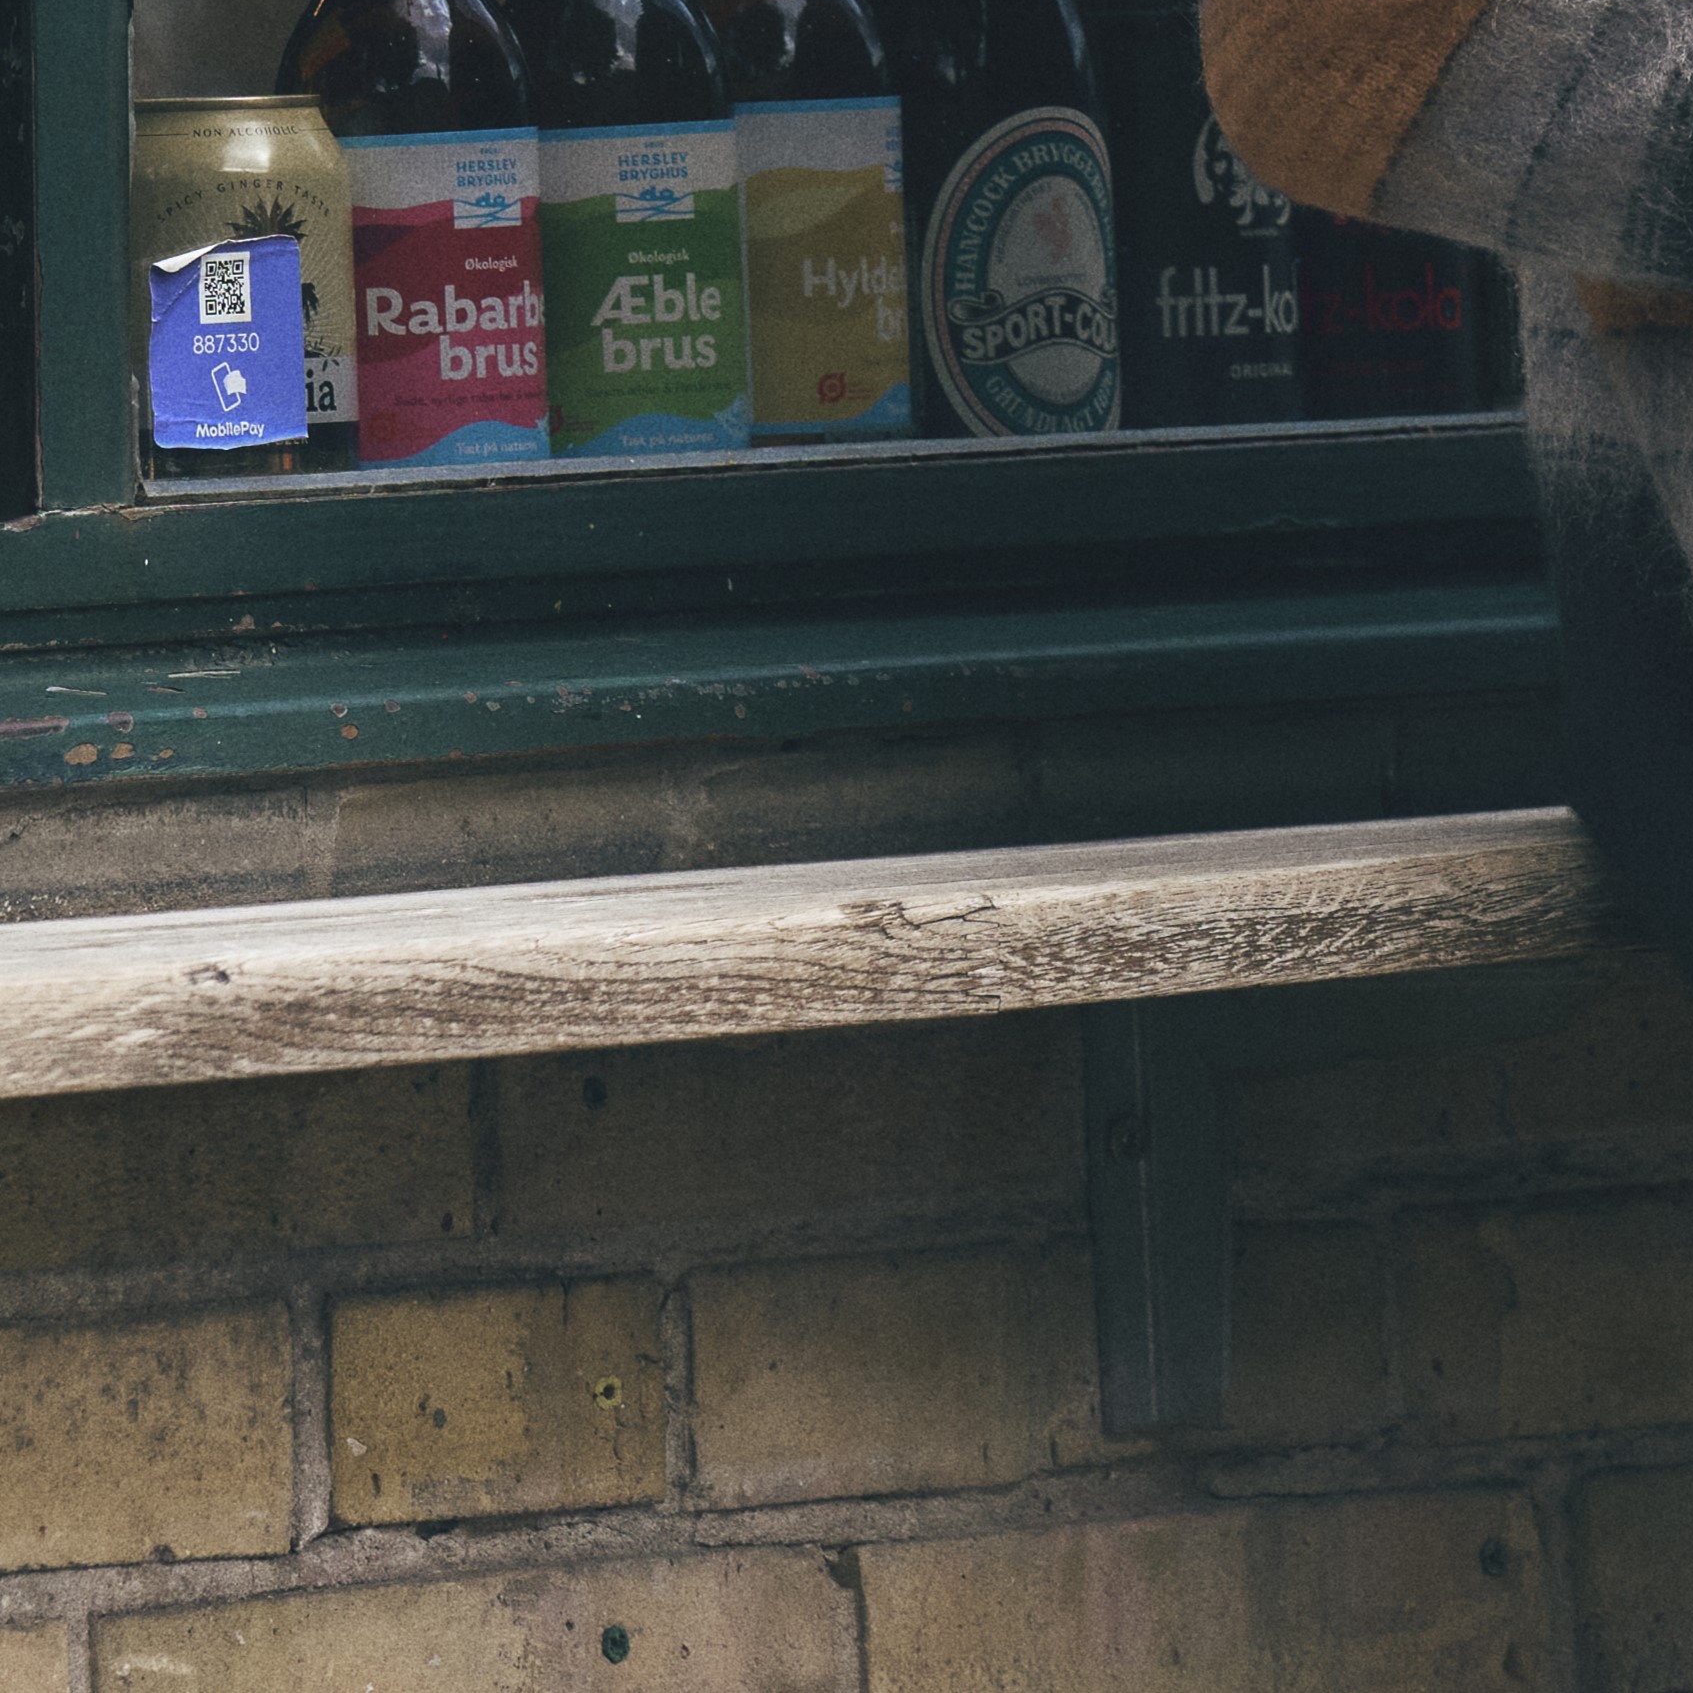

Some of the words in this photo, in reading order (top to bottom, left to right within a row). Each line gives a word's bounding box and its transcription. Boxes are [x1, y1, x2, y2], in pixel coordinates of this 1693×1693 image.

[192, 127, 222, 139] NON
[228, 125, 299, 138] ALCOHOLIC
[455, 158, 518, 174] HERSLEV
[618, 152, 689, 168] HERSLEV
[456, 172, 518, 188] BRYGHUS
[618, 166, 689, 182] BRYGHUS
[216, 178, 285, 195] GINGER
[954, 166, 1015, 291] HANCOCK
[464, 254, 518, 272] Økologisk
[627, 248, 691, 265] Økologisk
[366, 280, 545, 336] Rabarb
[590, 272, 722, 327] Æble
[192, 332, 260, 355] 887330
[601, 327, 719, 374] brus
[439, 334, 538, 381] brus
[195, 421, 265, 438] MobilePay
